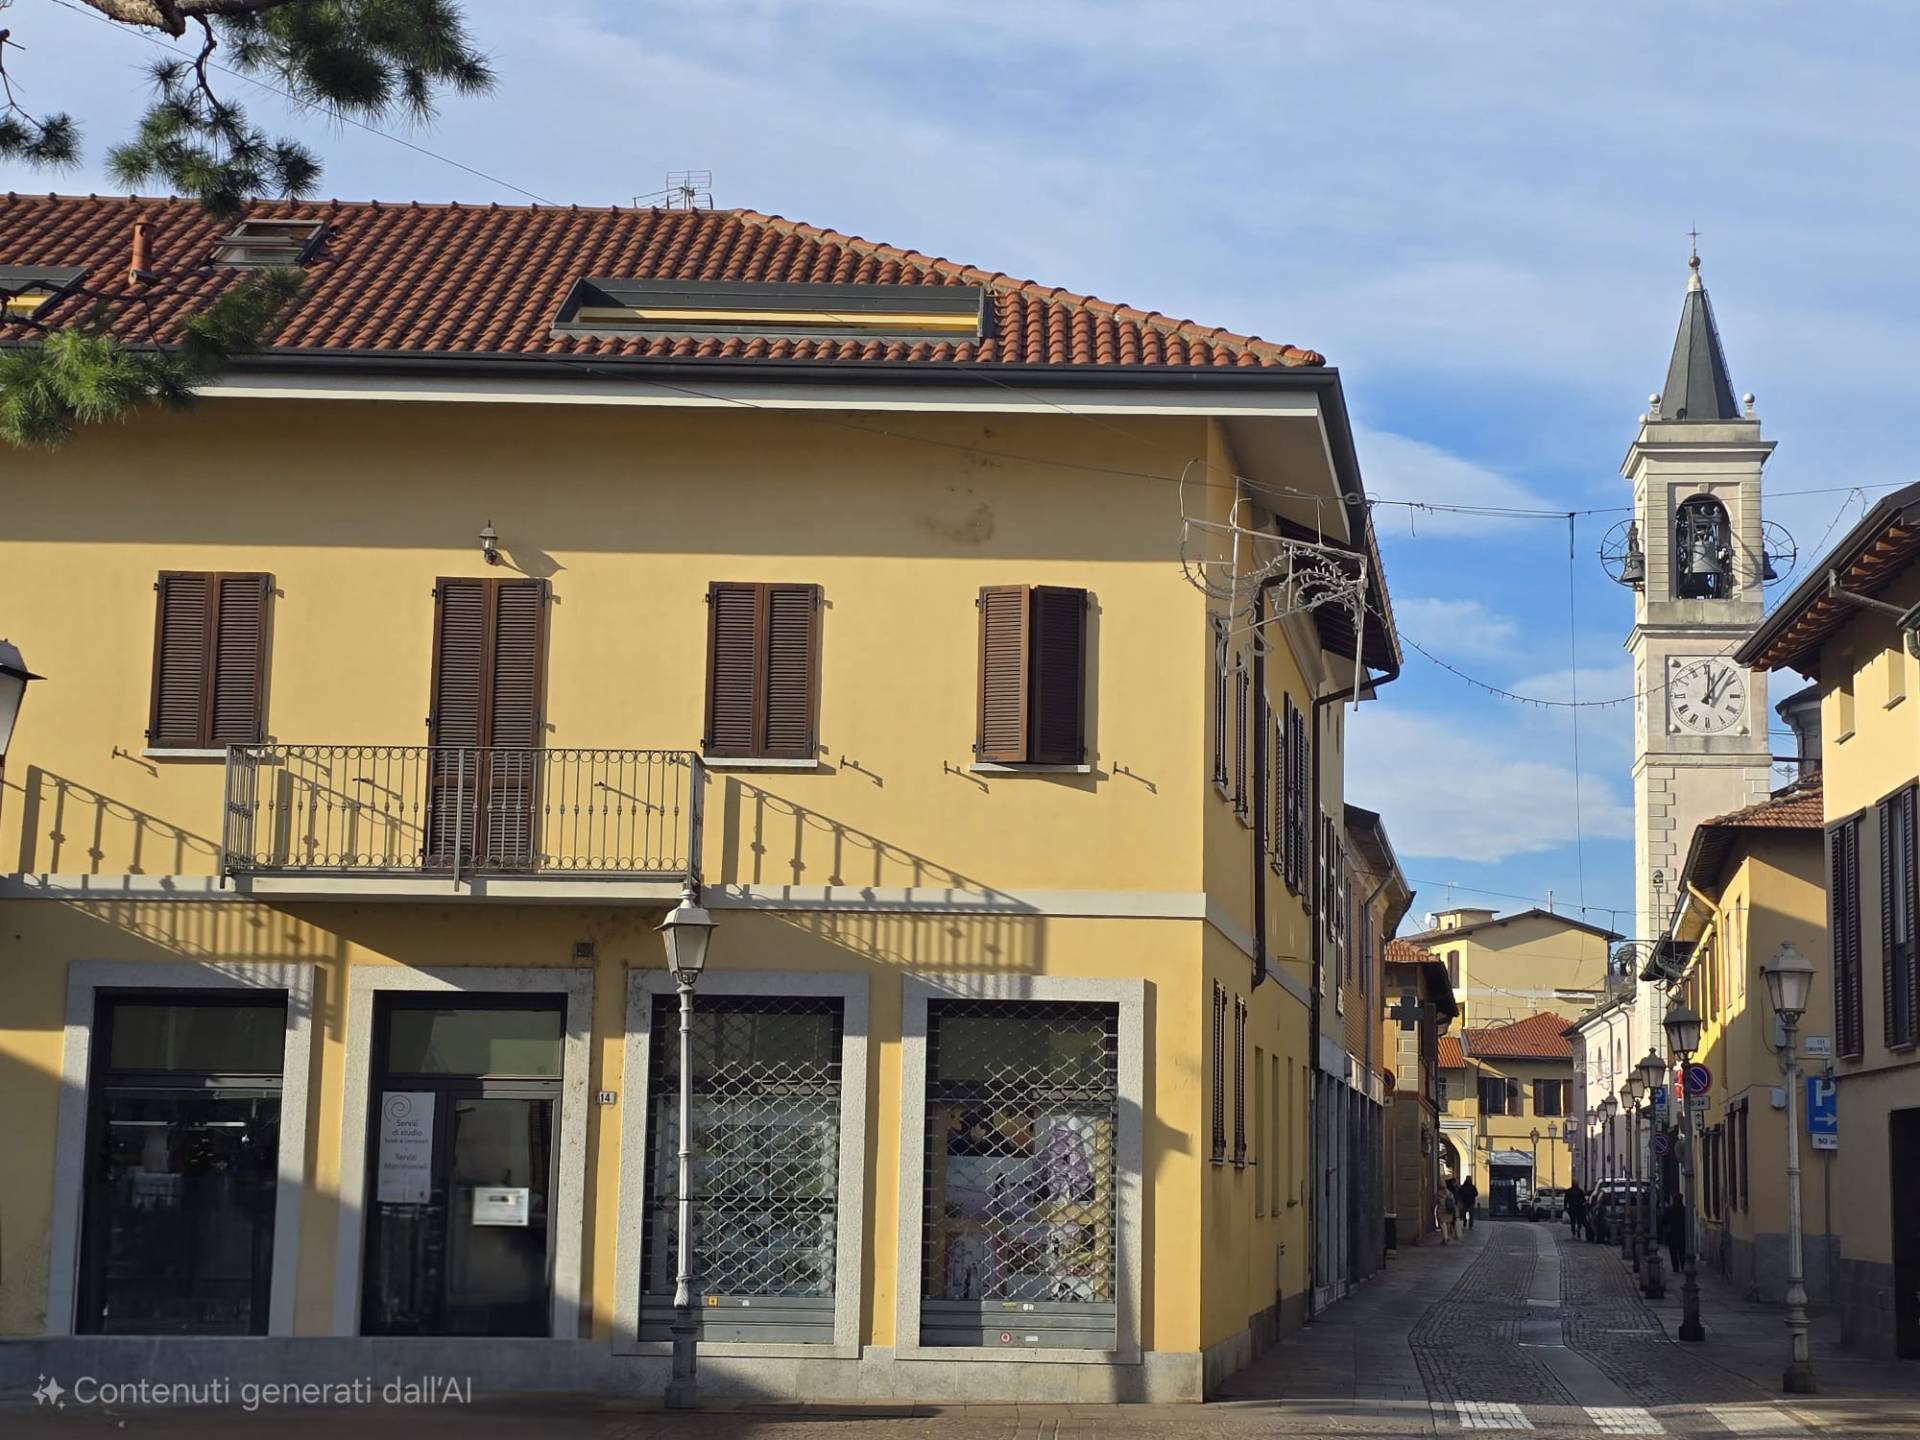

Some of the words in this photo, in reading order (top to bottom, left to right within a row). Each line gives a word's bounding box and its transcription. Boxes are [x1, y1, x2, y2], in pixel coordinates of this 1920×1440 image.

[601, 1093, 610, 1102] 14
[1815, 1079, 1837, 1107] P
[401, 1128, 424, 1137] studio
